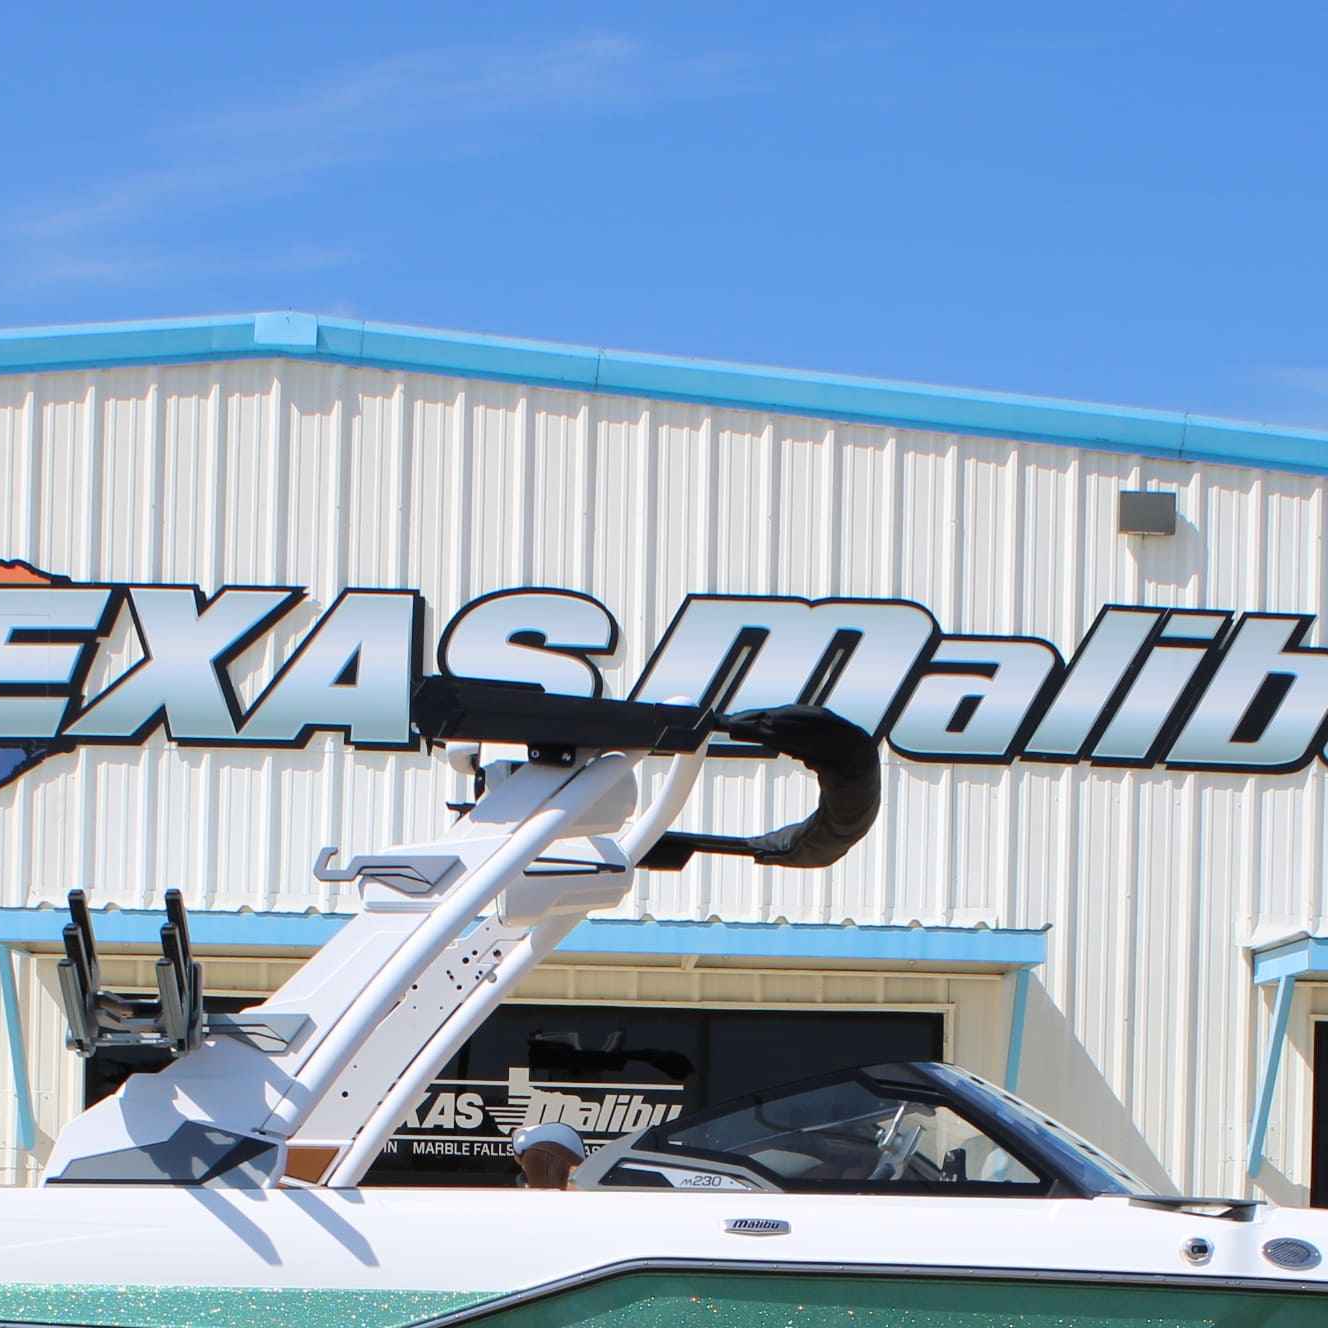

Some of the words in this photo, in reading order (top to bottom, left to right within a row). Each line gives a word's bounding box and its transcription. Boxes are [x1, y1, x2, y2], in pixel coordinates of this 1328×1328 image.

[412, 1141, 471, 1156] MARBLE
[473, 1142, 515, 1157] FALLS
[732, 1218, 780, 1230] Malibu
